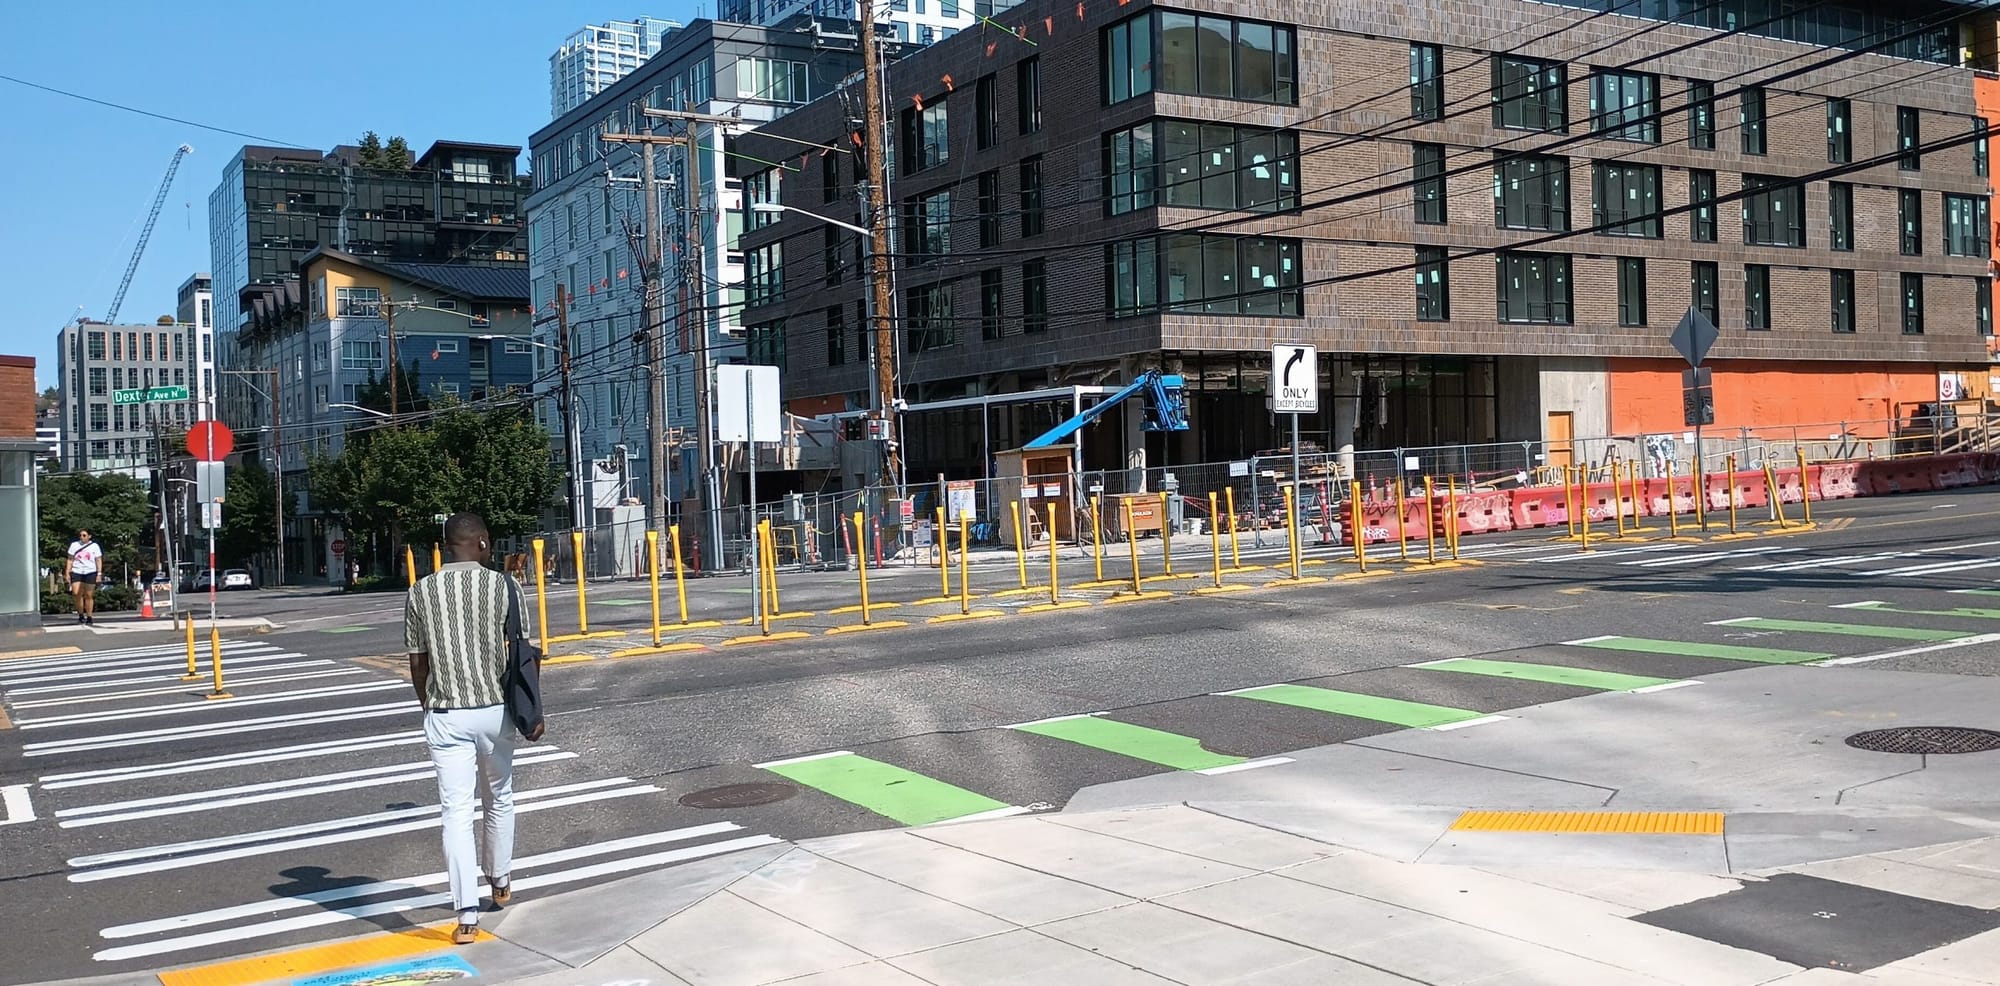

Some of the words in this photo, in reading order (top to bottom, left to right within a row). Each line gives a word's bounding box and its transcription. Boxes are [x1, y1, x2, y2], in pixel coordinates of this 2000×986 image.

[115, 391, 151, 402] Dexter
[1283, 387, 1308, 399] ONLY
[1277, 400, 1293, 408] EXCEPT
[1295, 400, 1315, 408] BICYCLES
